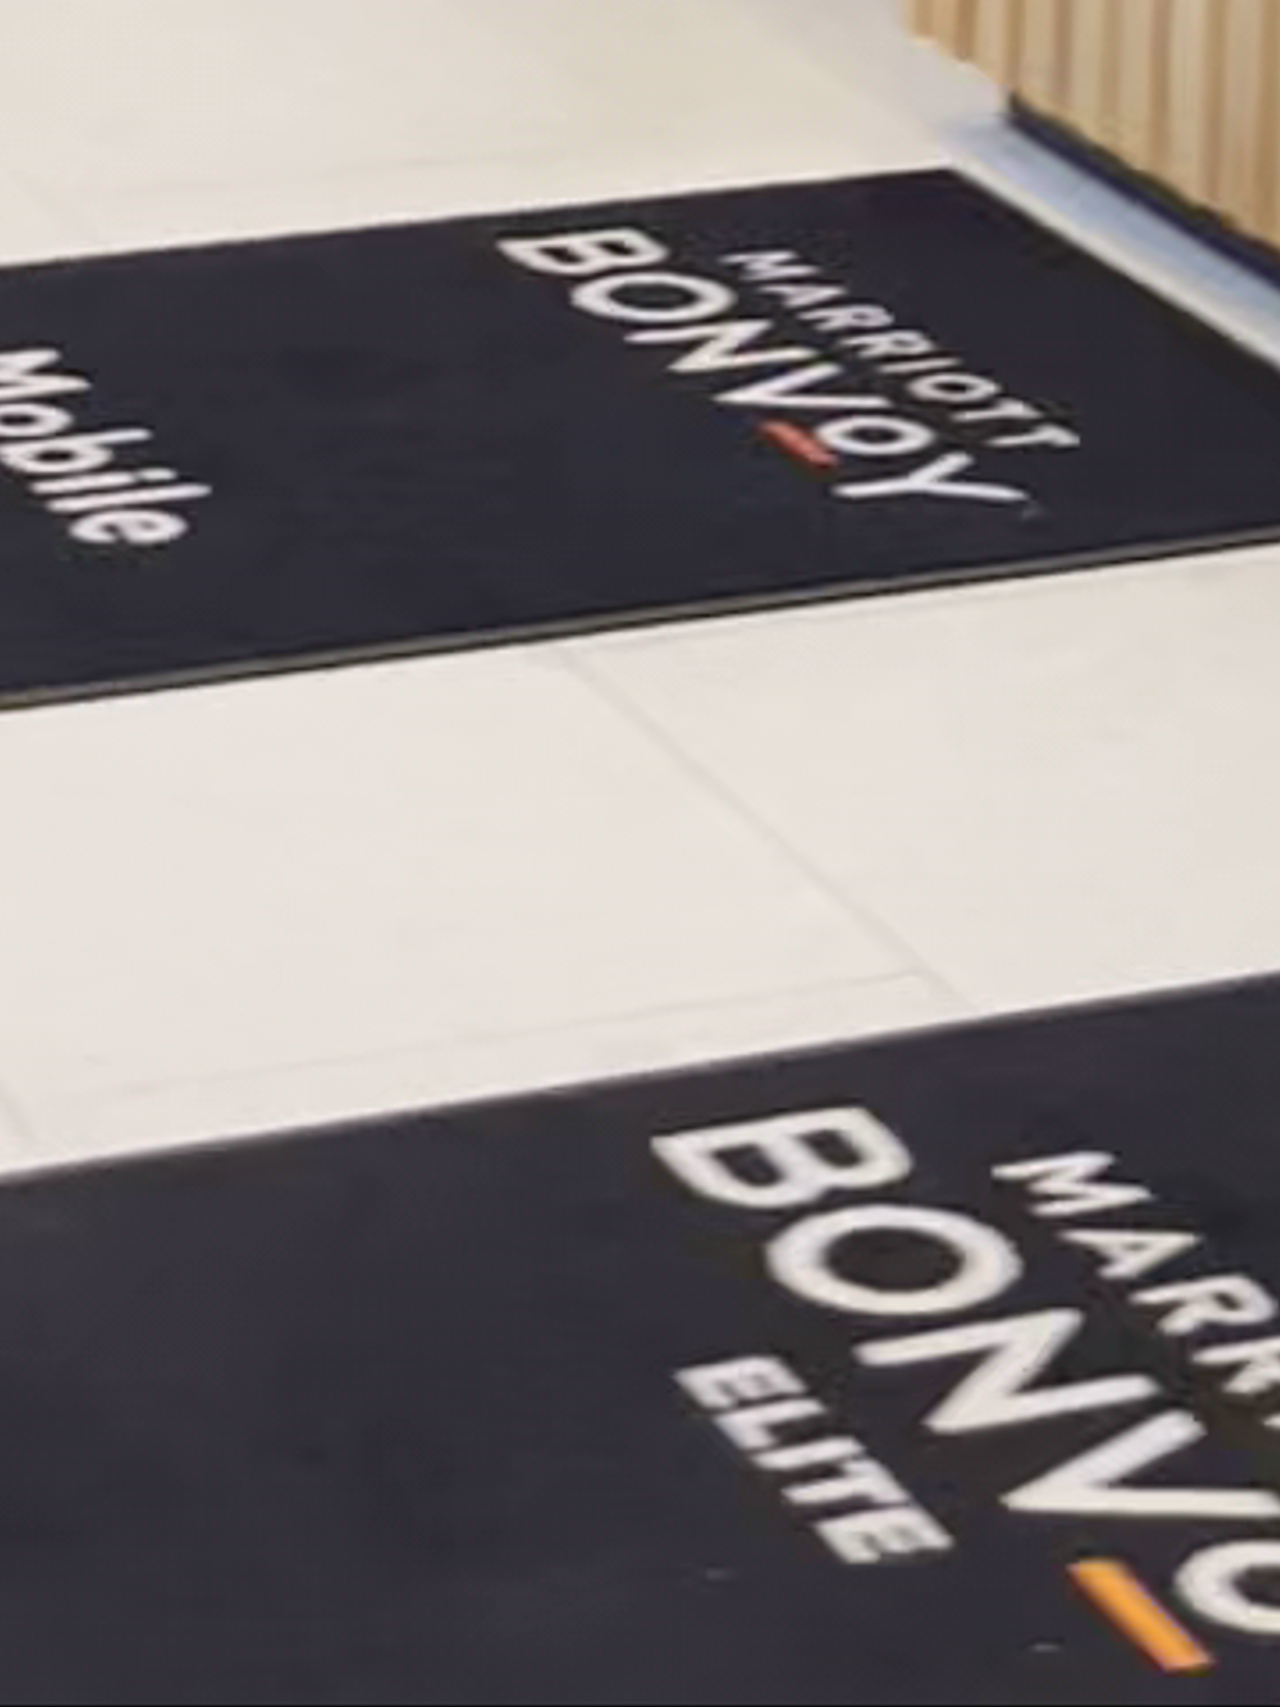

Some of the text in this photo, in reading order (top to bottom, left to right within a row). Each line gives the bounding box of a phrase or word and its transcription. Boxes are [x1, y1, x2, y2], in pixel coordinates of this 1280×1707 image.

[495, 226, 1028, 501] BONVOY
[719, 250, 1081, 448] MARRIOTT
[673, 1354, 954, 1566] ELITE
